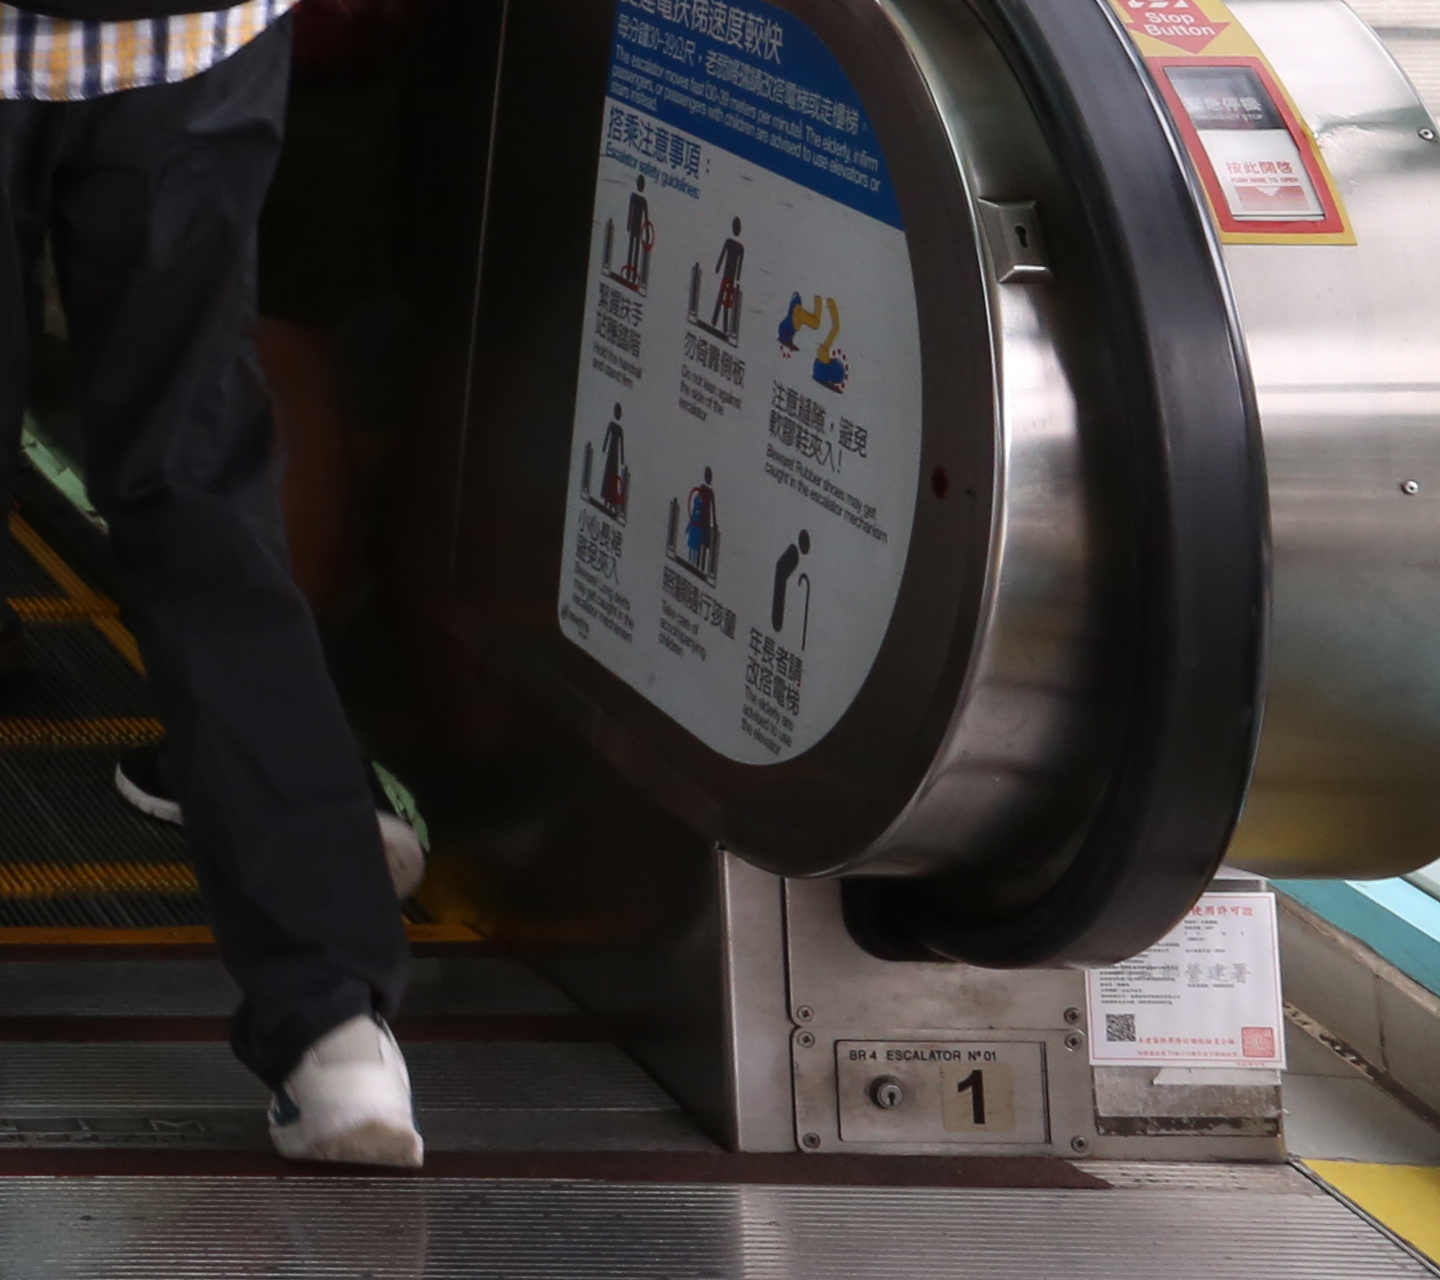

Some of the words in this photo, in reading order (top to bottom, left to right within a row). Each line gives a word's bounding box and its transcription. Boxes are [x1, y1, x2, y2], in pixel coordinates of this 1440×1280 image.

[1144, 11, 1195, 26] Stop
[1147, 23, 1216, 37] Button
[849, 1049, 867, 1061] BR
[868, 1049, 878, 1061] 4
[886, 1049, 963, 1062] ESCALATOR
[957, 1069, 987, 1125] 1
